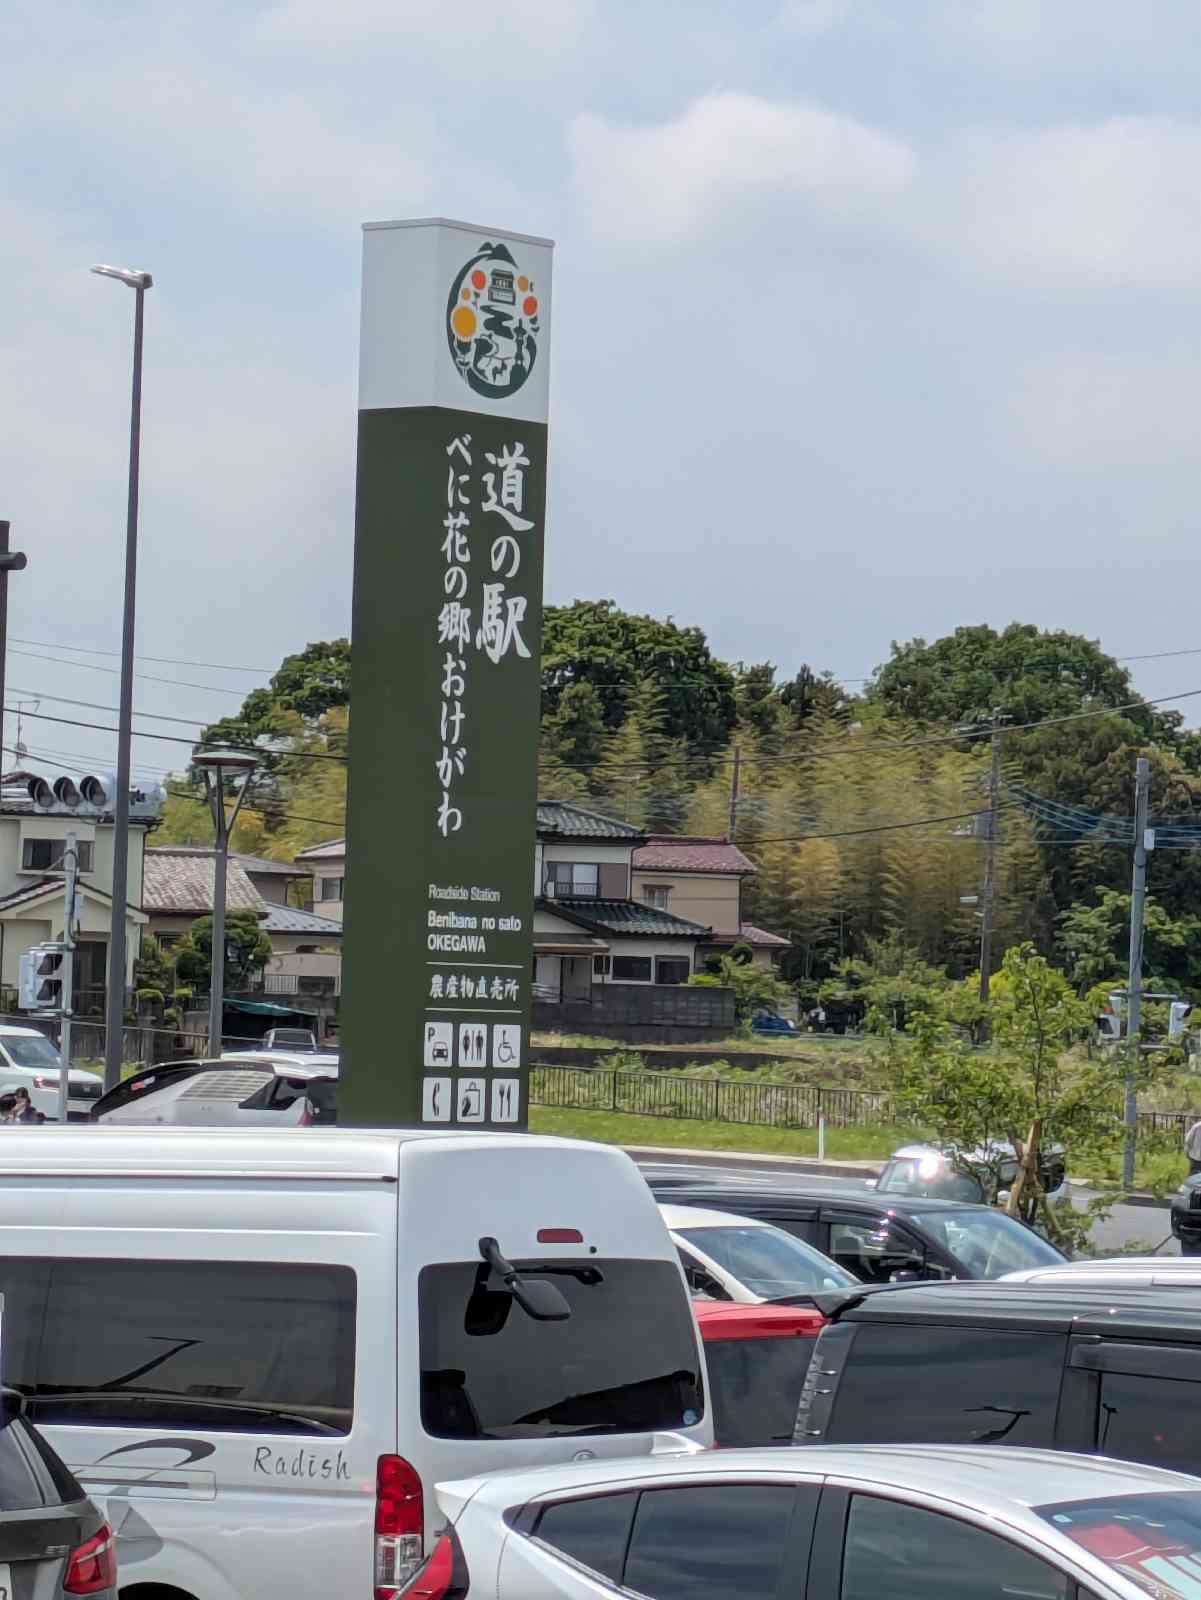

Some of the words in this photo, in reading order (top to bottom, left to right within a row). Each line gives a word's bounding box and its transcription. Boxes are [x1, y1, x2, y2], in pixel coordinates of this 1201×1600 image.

[475, 442, 535, 665] 道の駅
[435, 433, 473, 837] べに花の郷おけがわ
[470, 886, 501, 902] Station
[427, 909, 477, 930] Benibana
[481, 917, 496, 931] no
[498, 915, 522, 932] sato
[427, 933, 486, 953] OKEGAWA
[429, 973, 520, 1002] 農産物直売所
[427, 1026, 436, 1042] P
[253, 1445, 351, 1480] Radish
